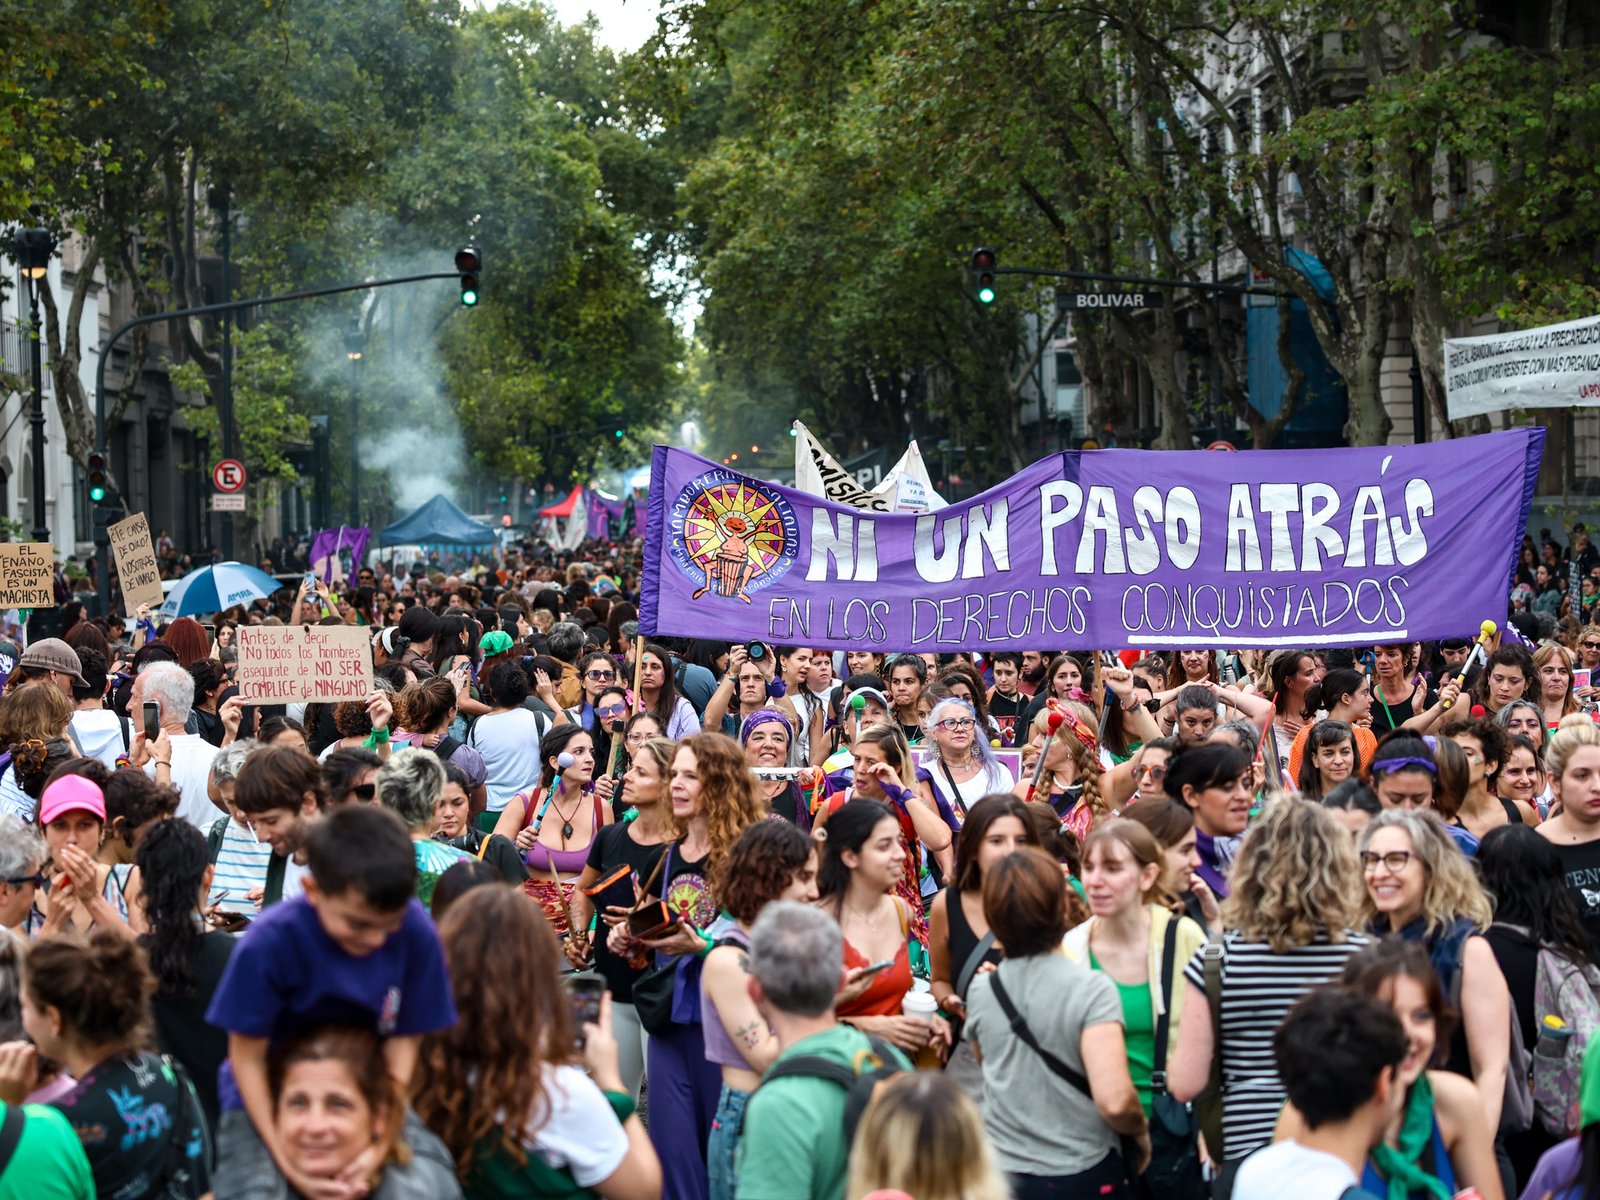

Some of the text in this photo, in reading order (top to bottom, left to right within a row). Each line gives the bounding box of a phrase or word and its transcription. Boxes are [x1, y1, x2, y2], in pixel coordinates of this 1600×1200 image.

[1076, 293, 1144, 307] BOLIVAR
[1538, 333, 1549, 349] LA
[1503, 359, 1530, 378] RESISTE
[1529, 358, 1545, 374] CON
[1578, 384, 1589, 398] LA
[804, 454, 1434, 583] NI UN PASO ATRÁS
[19, 545, 37, 555] EL
[119, 544, 129, 560] DE
[121, 555, 155, 577] NOSOTRAS
[7, 578, 38, 588] ES UN
[125, 580, 136, 592] DE
[0, 589, 50, 604] MACHISTA
[227, 589, 254, 603] AMRA
[768, 596, 811, 639] EN
[827, 596, 890, 643] LOS
[911, 586, 1092, 644] DERECHOS
[240, 628, 330, 645] Antes de decir
[266, 645, 292, 659] todos
[298, 644, 313, 659] los
[243, 660, 364, 681] asegurate de NO SER
[243, 680, 367, 700] COMPLICE de NINGUNO
